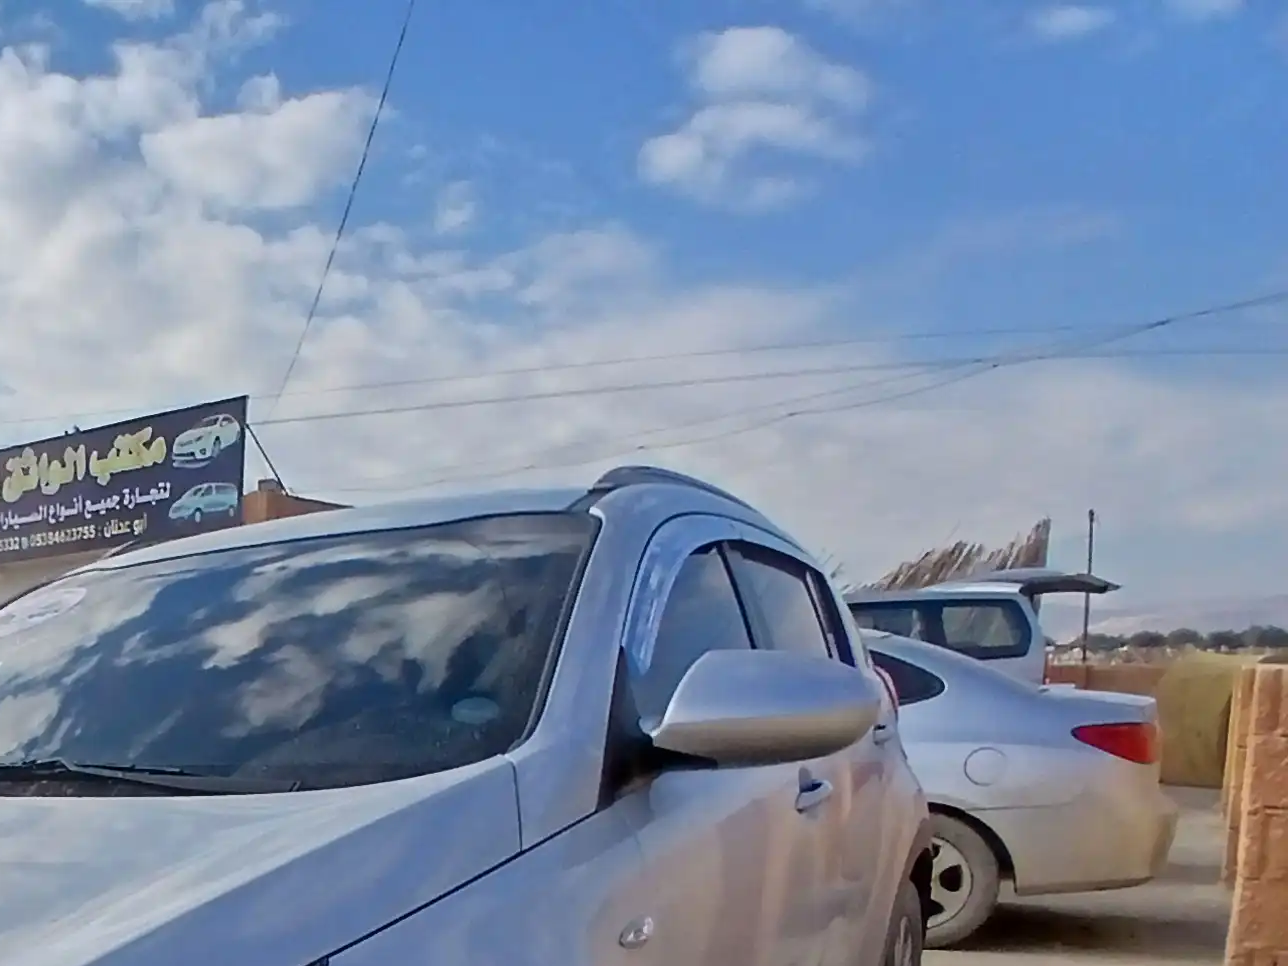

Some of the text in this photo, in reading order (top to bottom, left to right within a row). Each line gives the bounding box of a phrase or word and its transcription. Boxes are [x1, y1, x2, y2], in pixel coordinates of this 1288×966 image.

[2, 444, 86, 503] الواثق
[89, 426, 167, 486] مكتب
[84, 494, 120, 519] جميع
[122, 481, 171, 510] لتجارة
